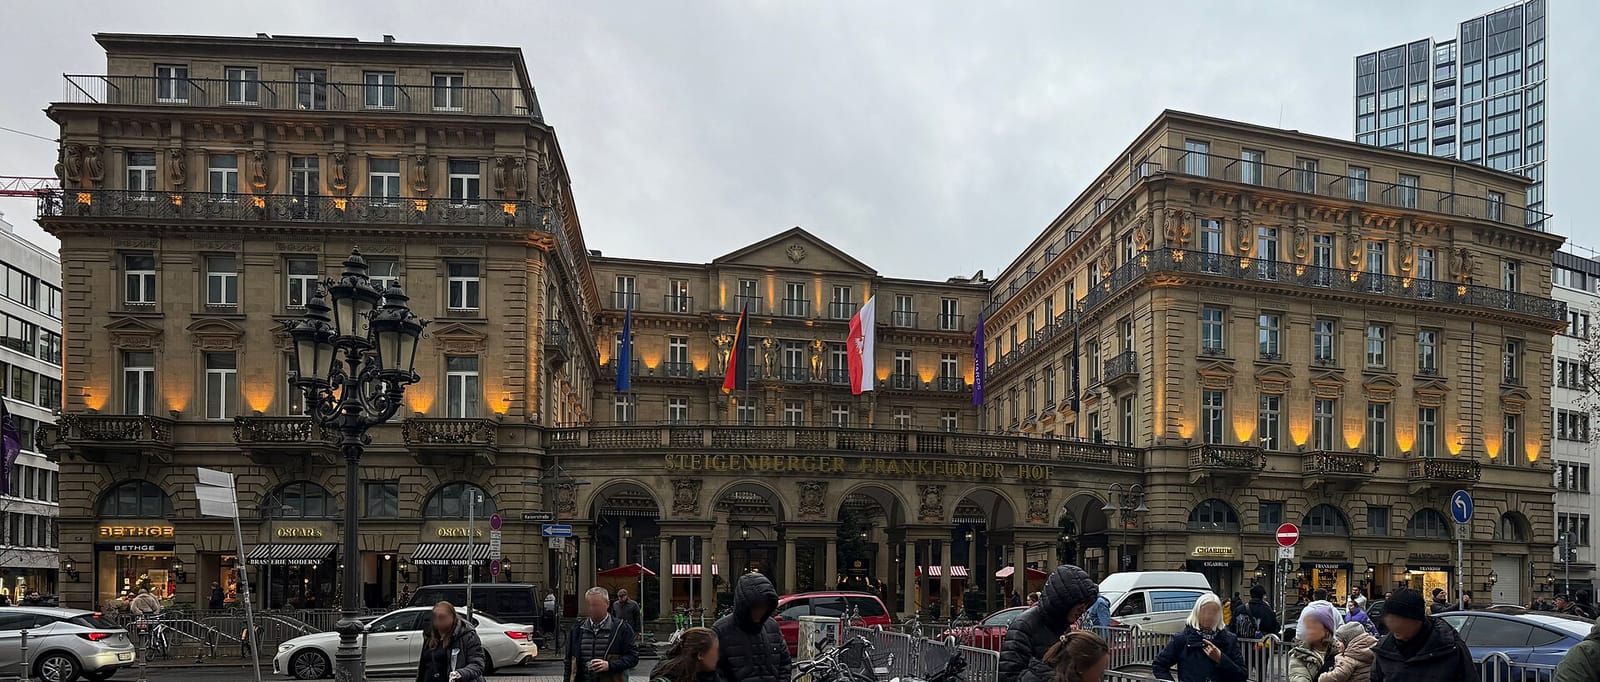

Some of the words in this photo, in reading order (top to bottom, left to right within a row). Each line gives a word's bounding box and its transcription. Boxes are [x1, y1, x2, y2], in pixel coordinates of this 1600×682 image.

[664, 453, 845, 473] STEIGENBERGER
[859, 458, 1004, 479] FRANKFURTER
[1016, 464, 1054, 480] HOF
[99, 526, 175, 538] BETHGE
